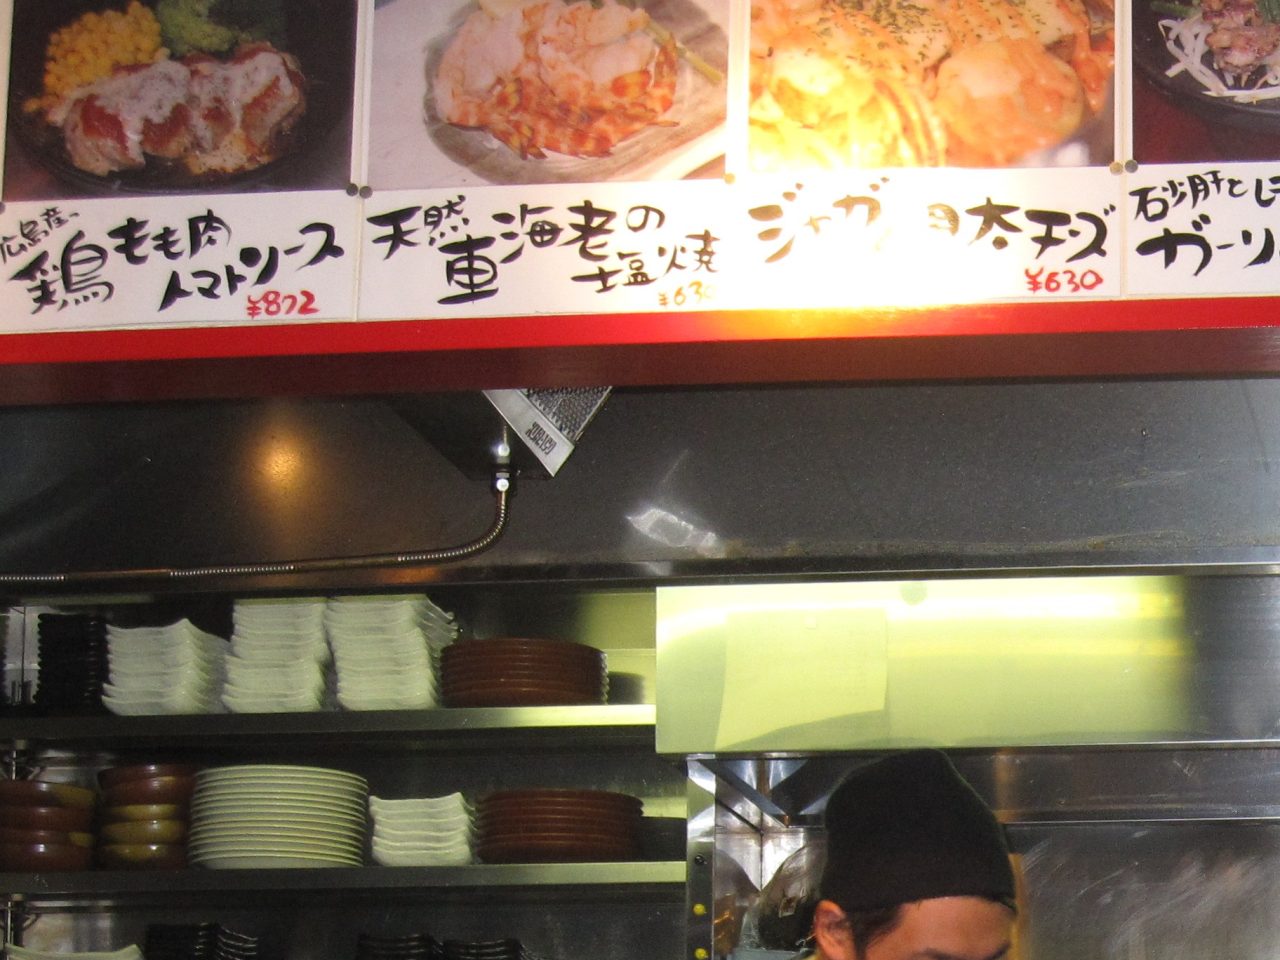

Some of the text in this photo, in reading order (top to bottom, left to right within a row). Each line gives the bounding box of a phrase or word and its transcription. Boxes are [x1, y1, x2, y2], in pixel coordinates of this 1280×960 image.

[158, 222, 345, 312] トマトソース
[1025, 267, 1104, 293] ¥630
